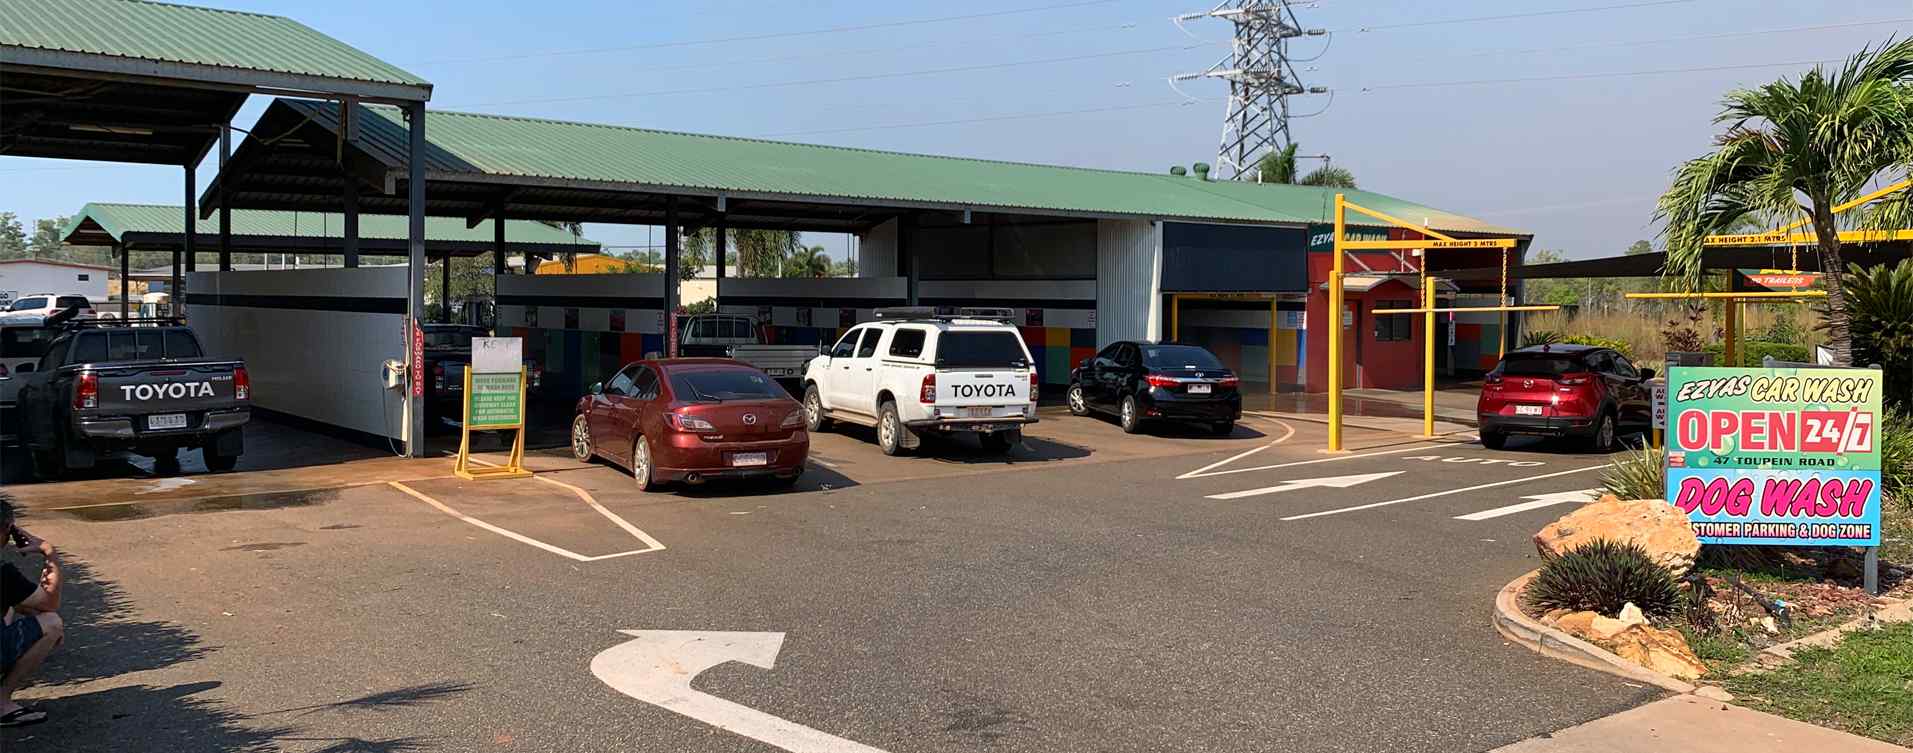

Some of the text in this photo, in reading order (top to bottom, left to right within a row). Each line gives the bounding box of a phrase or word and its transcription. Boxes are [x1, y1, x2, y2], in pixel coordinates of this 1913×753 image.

[1311, 232, 1335, 246] EZYA
[121, 381, 215, 401] TOYOTA
[951, 384, 1016, 398] TOYOTA
[1677, 375, 1752, 402] EZYAS
[1751, 376, 1800, 403] CAR
[1803, 377, 1874, 403] WASH
[1677, 407, 1872, 455] OPEN 24/7
[1401, 455, 1546, 466] AUTO
[1713, 456, 1835, 466] 47 TOUPEIN ROAD
[1674, 477, 1874, 517] DOG WASH
[1690, 522, 1871, 538] STOMER PARKING & DOG ZONE
